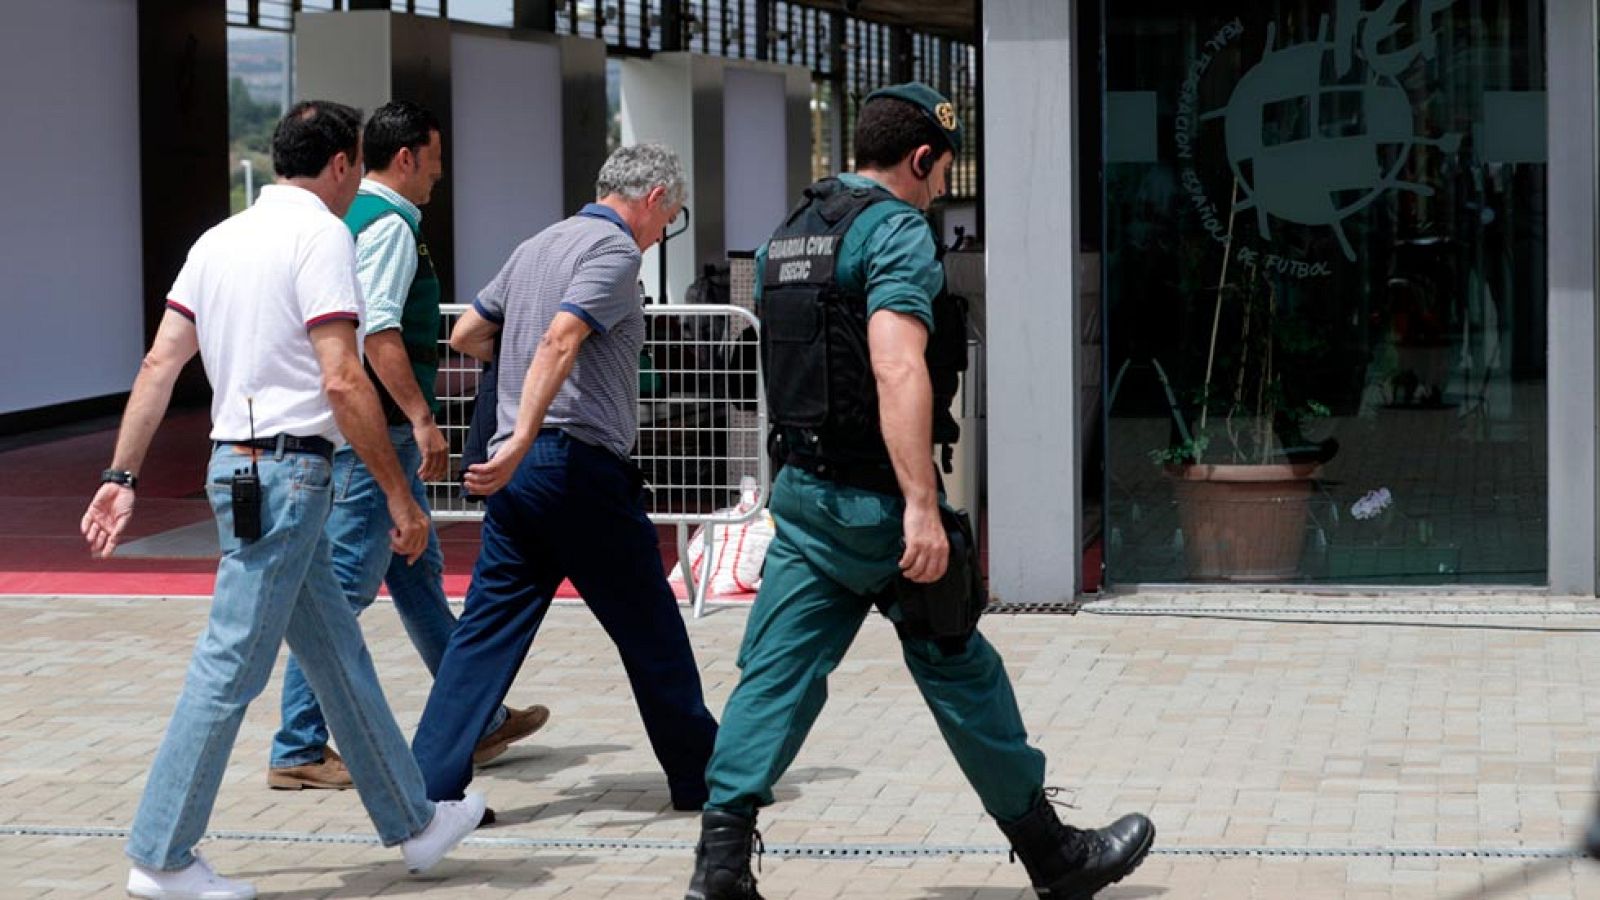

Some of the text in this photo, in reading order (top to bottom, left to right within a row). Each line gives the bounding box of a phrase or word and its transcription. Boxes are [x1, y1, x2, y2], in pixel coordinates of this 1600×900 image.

[1206, 16, 1244, 52] REAL
[1236, 246, 1259, 267] DE
[1264, 254, 1333, 278] FUTBOL
[769, 236, 834, 260] GUARDIA CIVIL
